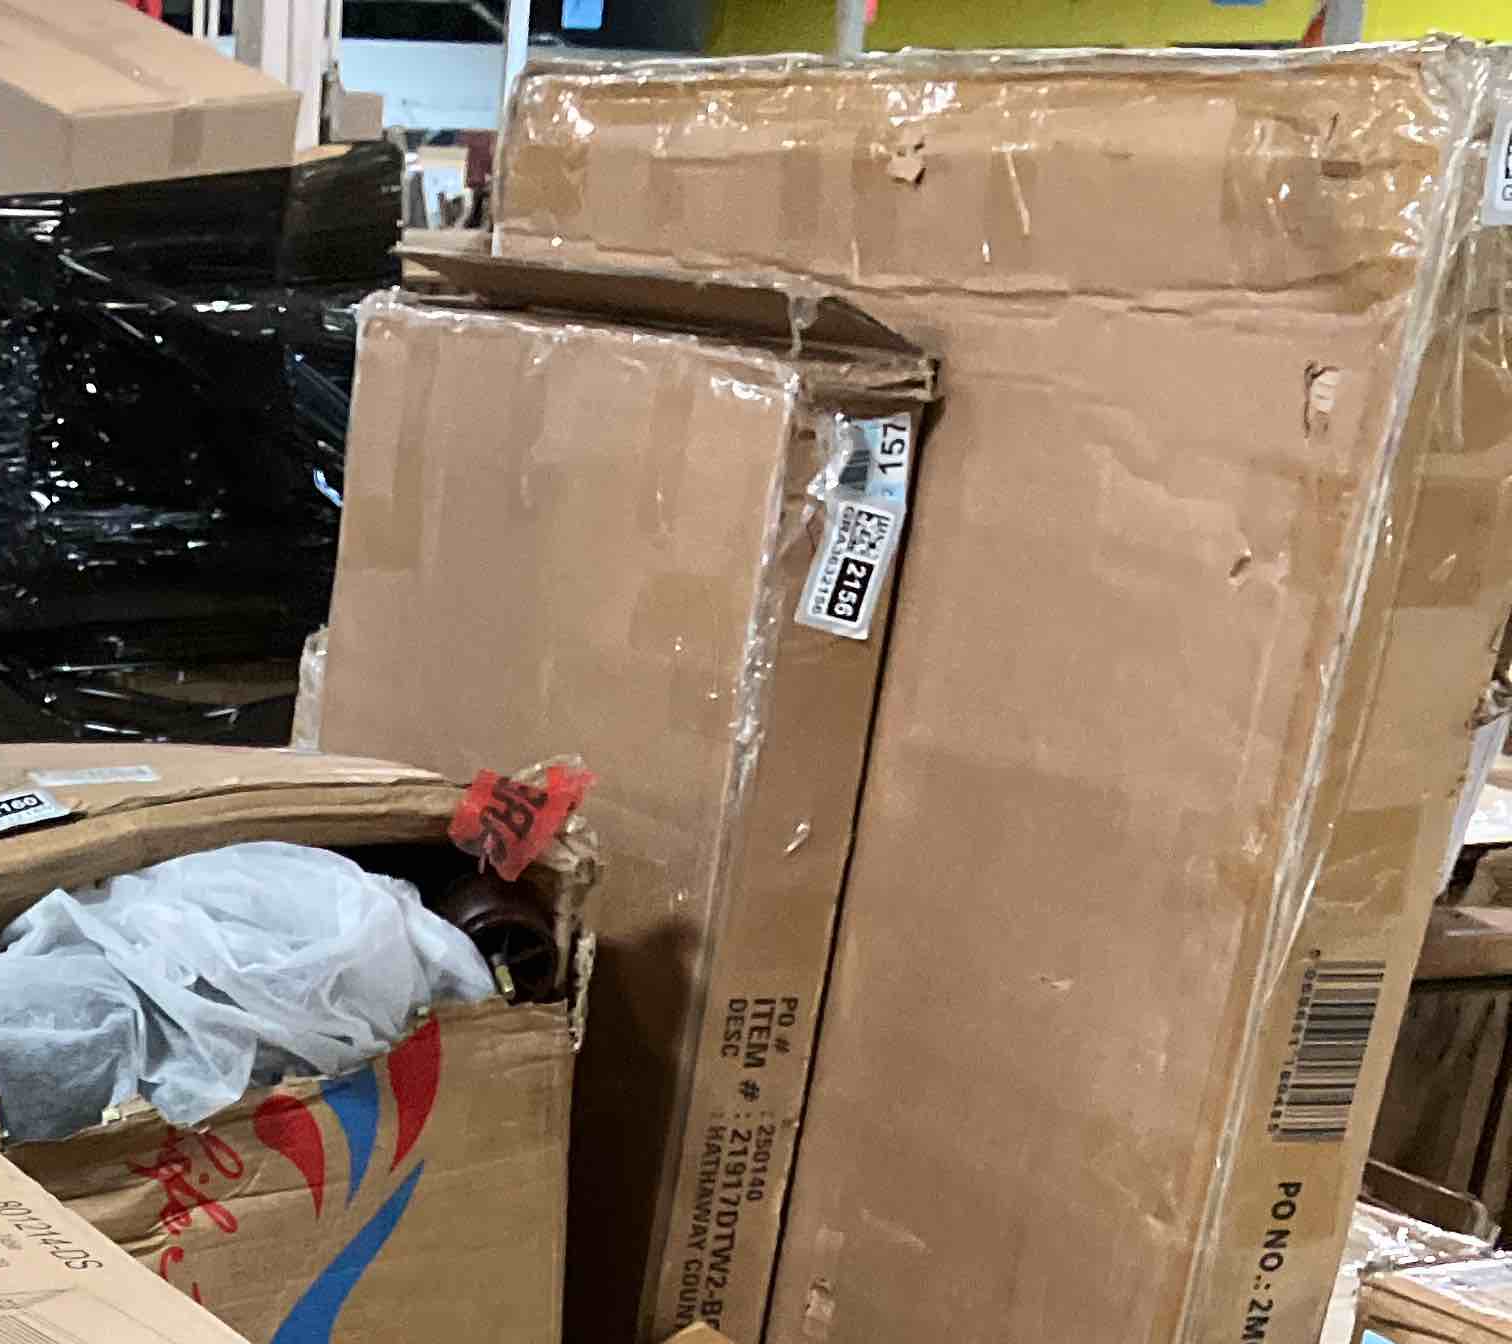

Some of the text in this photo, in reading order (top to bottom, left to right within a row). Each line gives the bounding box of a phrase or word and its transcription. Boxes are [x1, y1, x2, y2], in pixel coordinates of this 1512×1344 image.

[877, 423, 906, 475] 157
[833, 561, 866, 619] 2156
[720, 997, 749, 1058] DESC
[743, 998, 777, 1069] ITEM
[778, 997, 799, 1028] PO
[691, 1125, 727, 1251] HATHAWAY
[746, 1123, 776, 1202] 250140
[1270, 1182, 1302, 1221] PO
